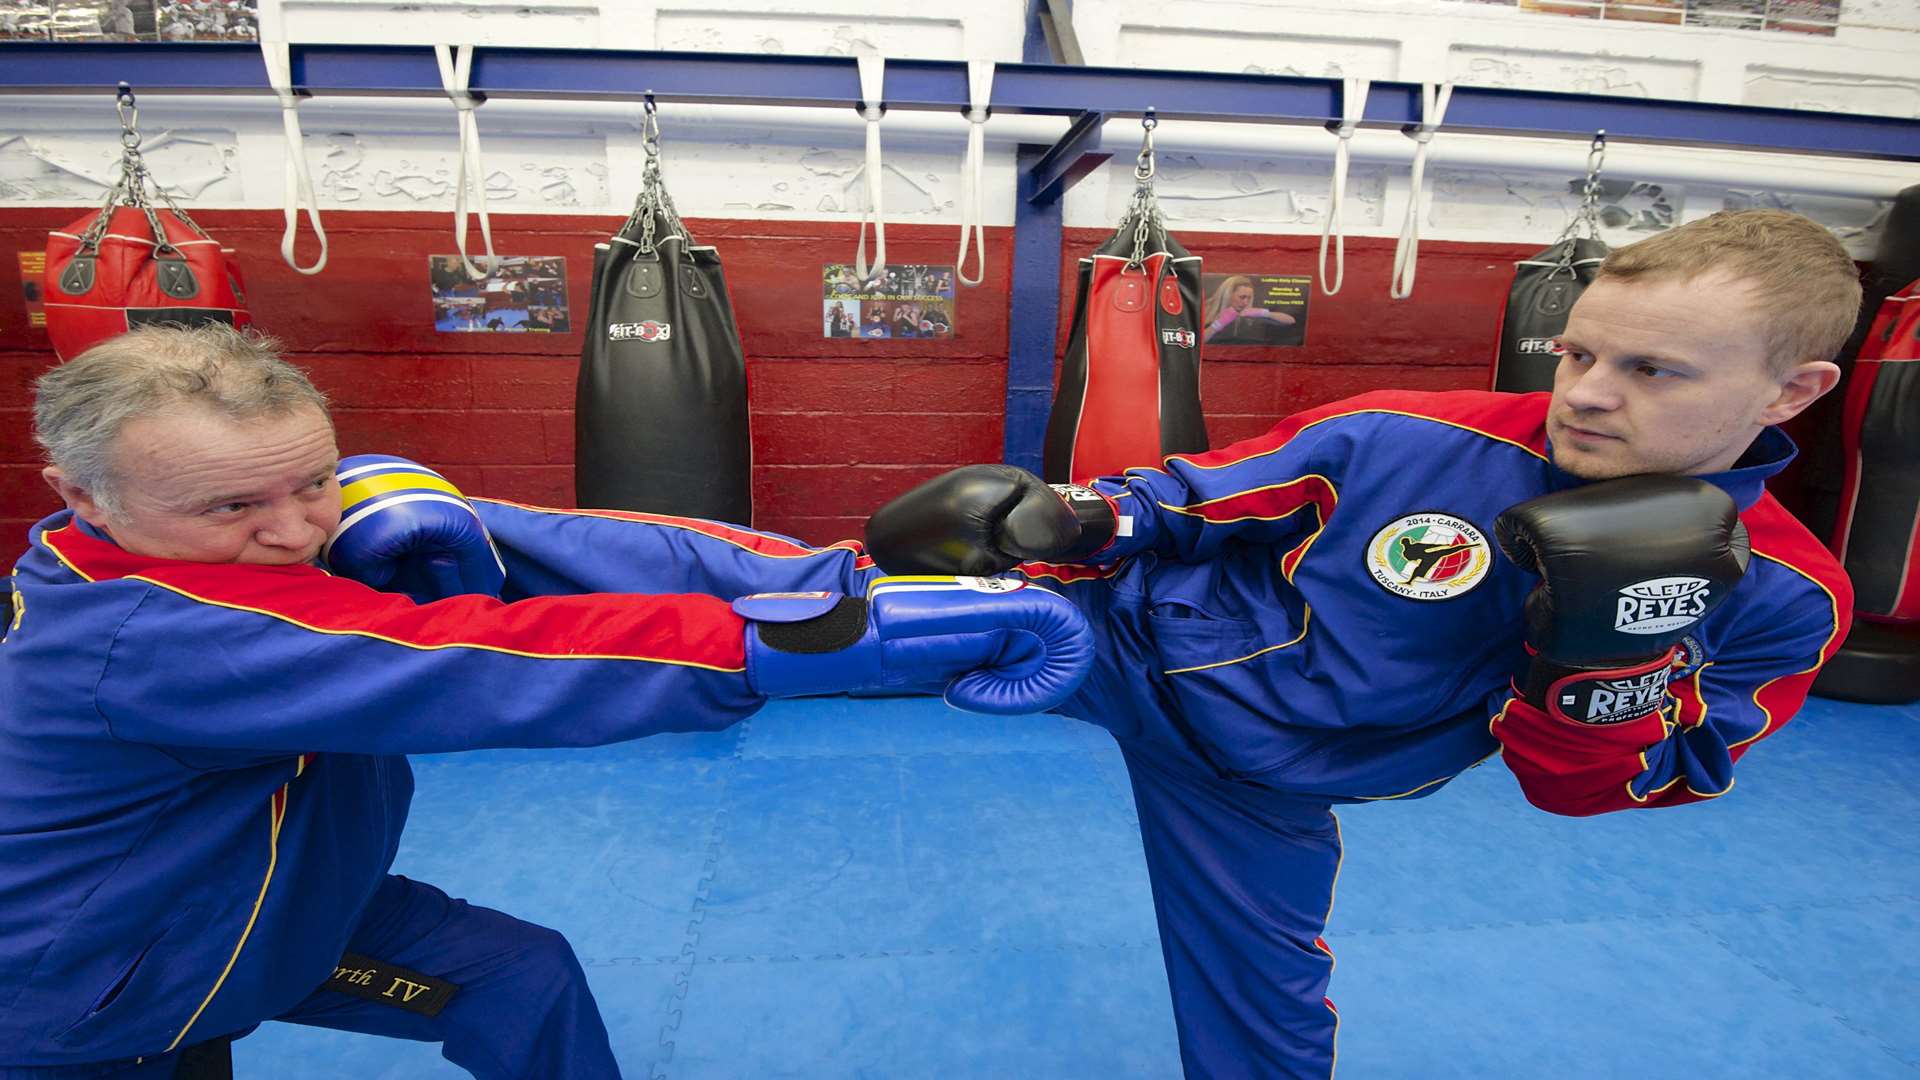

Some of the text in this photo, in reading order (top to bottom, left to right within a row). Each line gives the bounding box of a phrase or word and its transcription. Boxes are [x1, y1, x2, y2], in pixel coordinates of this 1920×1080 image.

[1406, 517, 1480, 542] 2014 CARRARA
[1374, 568, 1449, 598] TUSCANY ITALY
[1632, 581, 1701, 597] CLETO
[1615, 588, 1710, 629] REYES
[1587, 679, 1665, 719] REYE
[382, 977, 431, 1002] IV
